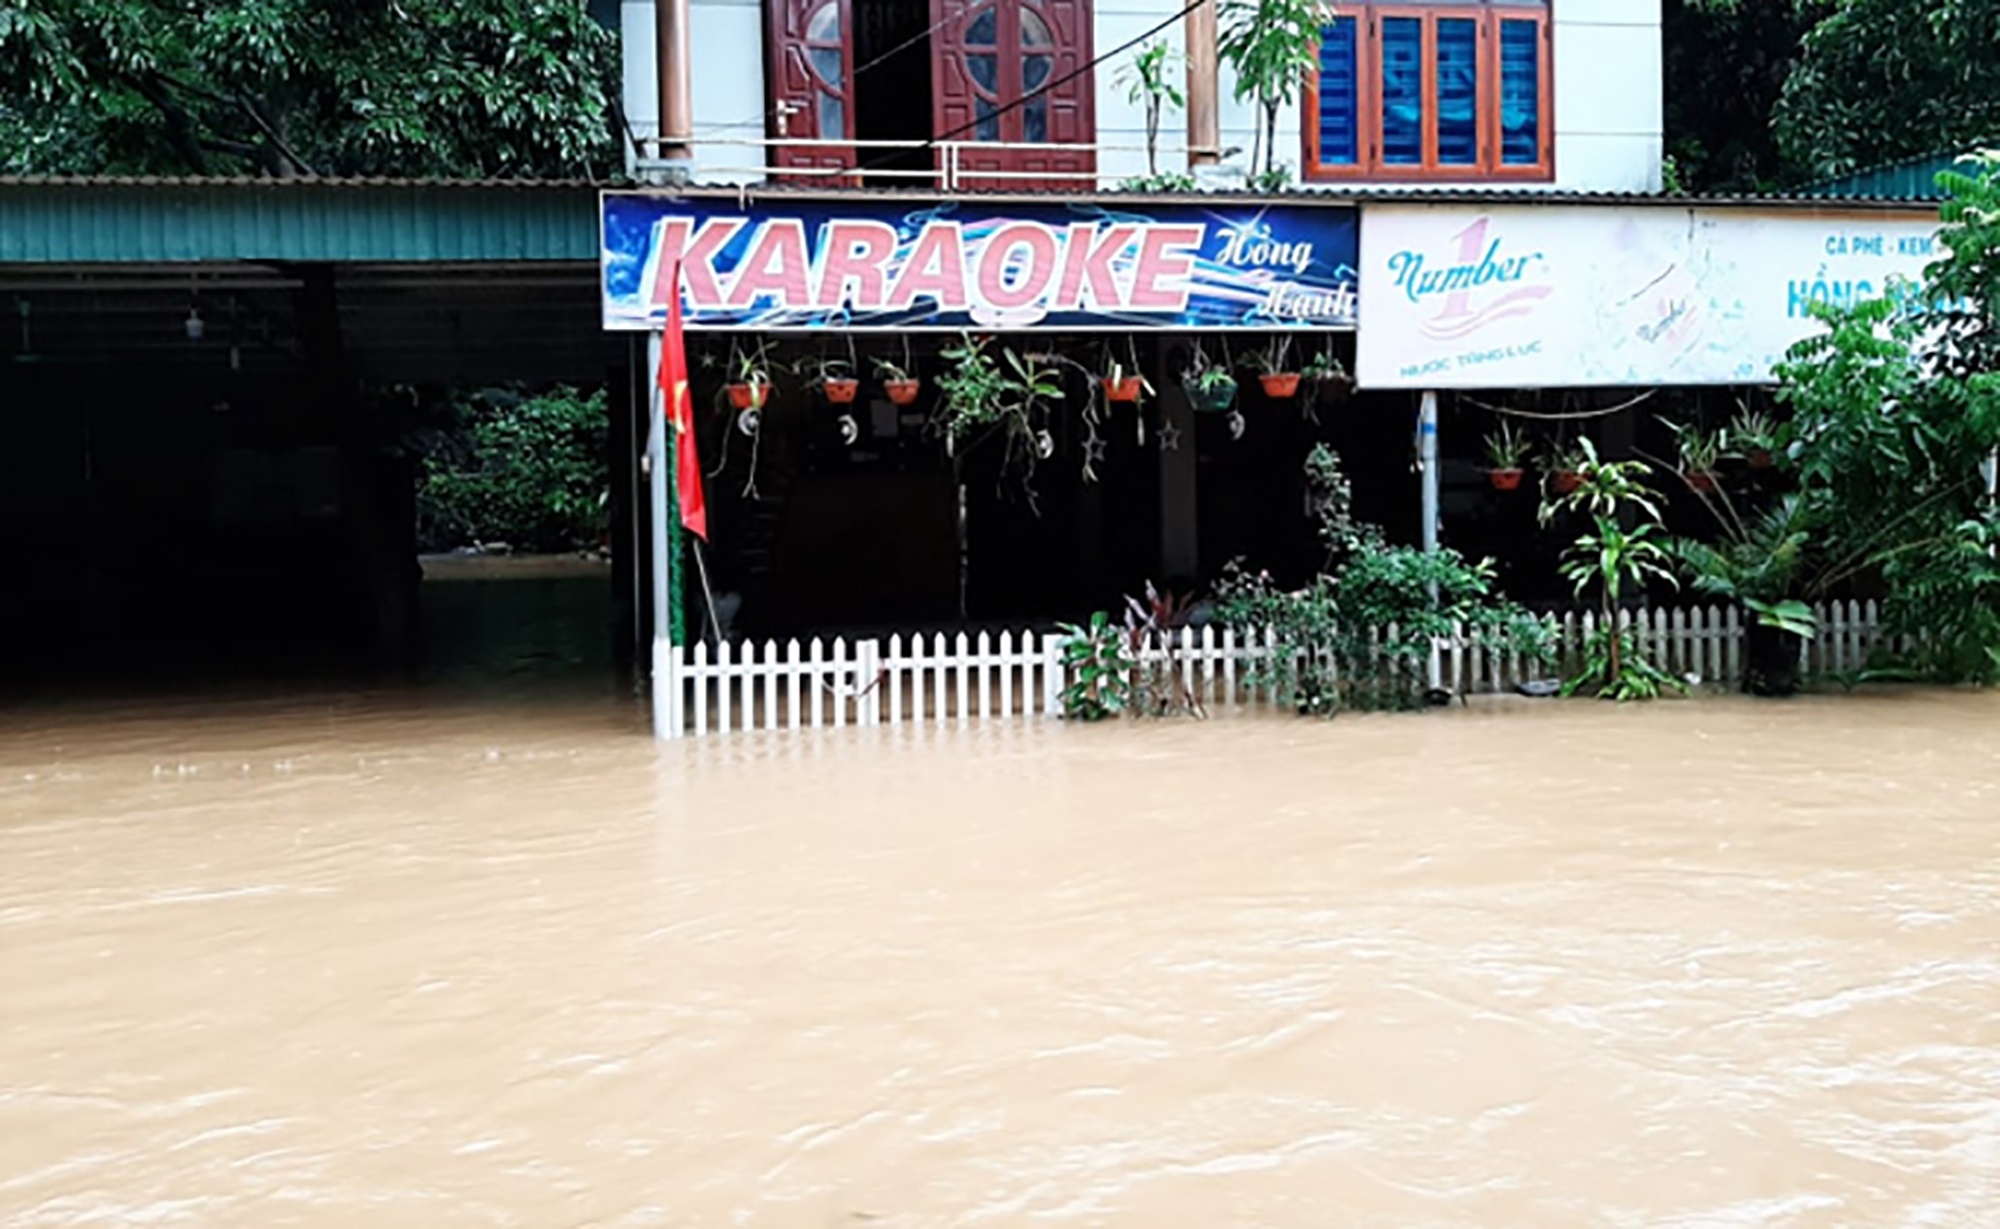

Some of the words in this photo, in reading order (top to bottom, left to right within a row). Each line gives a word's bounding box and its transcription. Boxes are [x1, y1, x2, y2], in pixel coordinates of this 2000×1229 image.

[649, 216, 1206, 311] KARAOKE
[1215, 224, 1313, 274] Hồng
[1388, 237, 1543, 303] Number
[1430, 214, 1489, 321] 1
